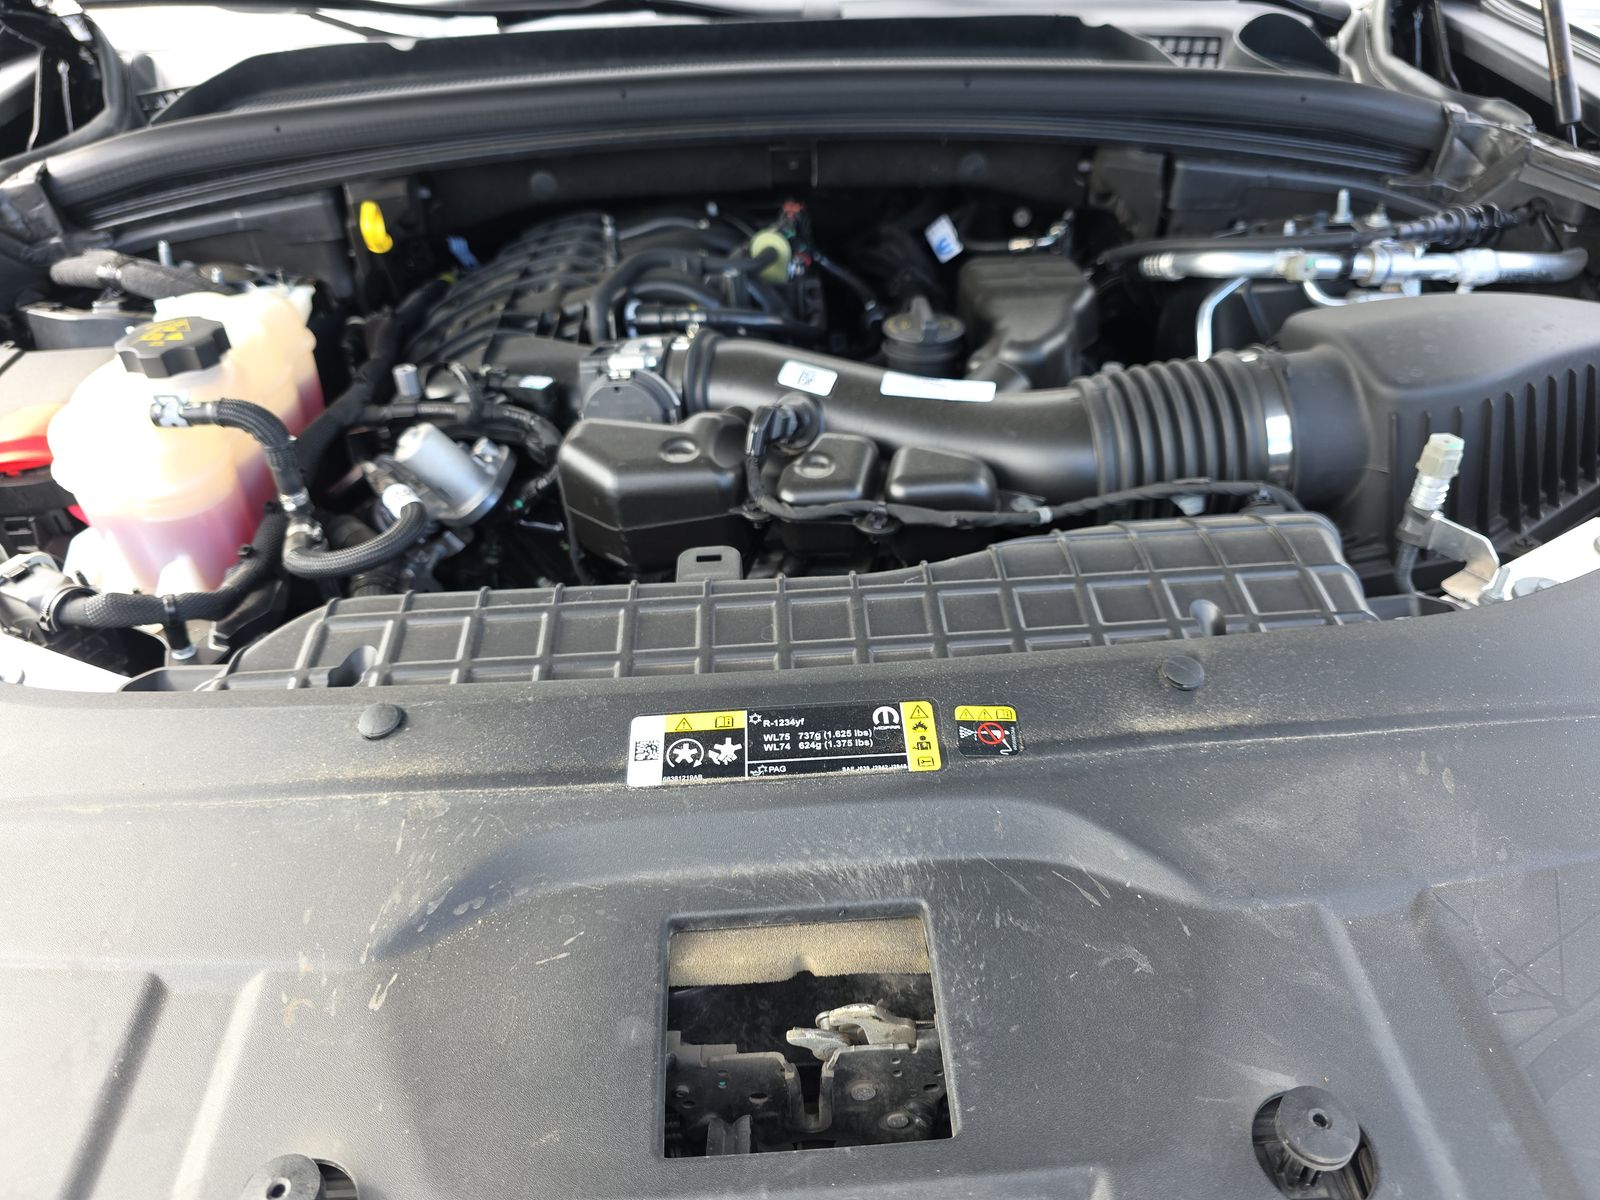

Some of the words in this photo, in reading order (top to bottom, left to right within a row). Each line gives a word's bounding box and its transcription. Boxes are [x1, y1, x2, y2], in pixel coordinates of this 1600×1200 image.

[762, 718, 805, 728] R-1234yf
[763, 733, 791, 742] WL75
[798, 731, 821, 741] 737g
[823, 729, 852, 739] (1.625
[854, 728, 873, 738] lbs)
[763, 742, 791, 751] WL74
[798, 741, 822, 750] 624g
[824, 739, 852, 749] (1.375
[855, 738, 874, 748] lbs)
[768, 765, 787, 773] PAG
